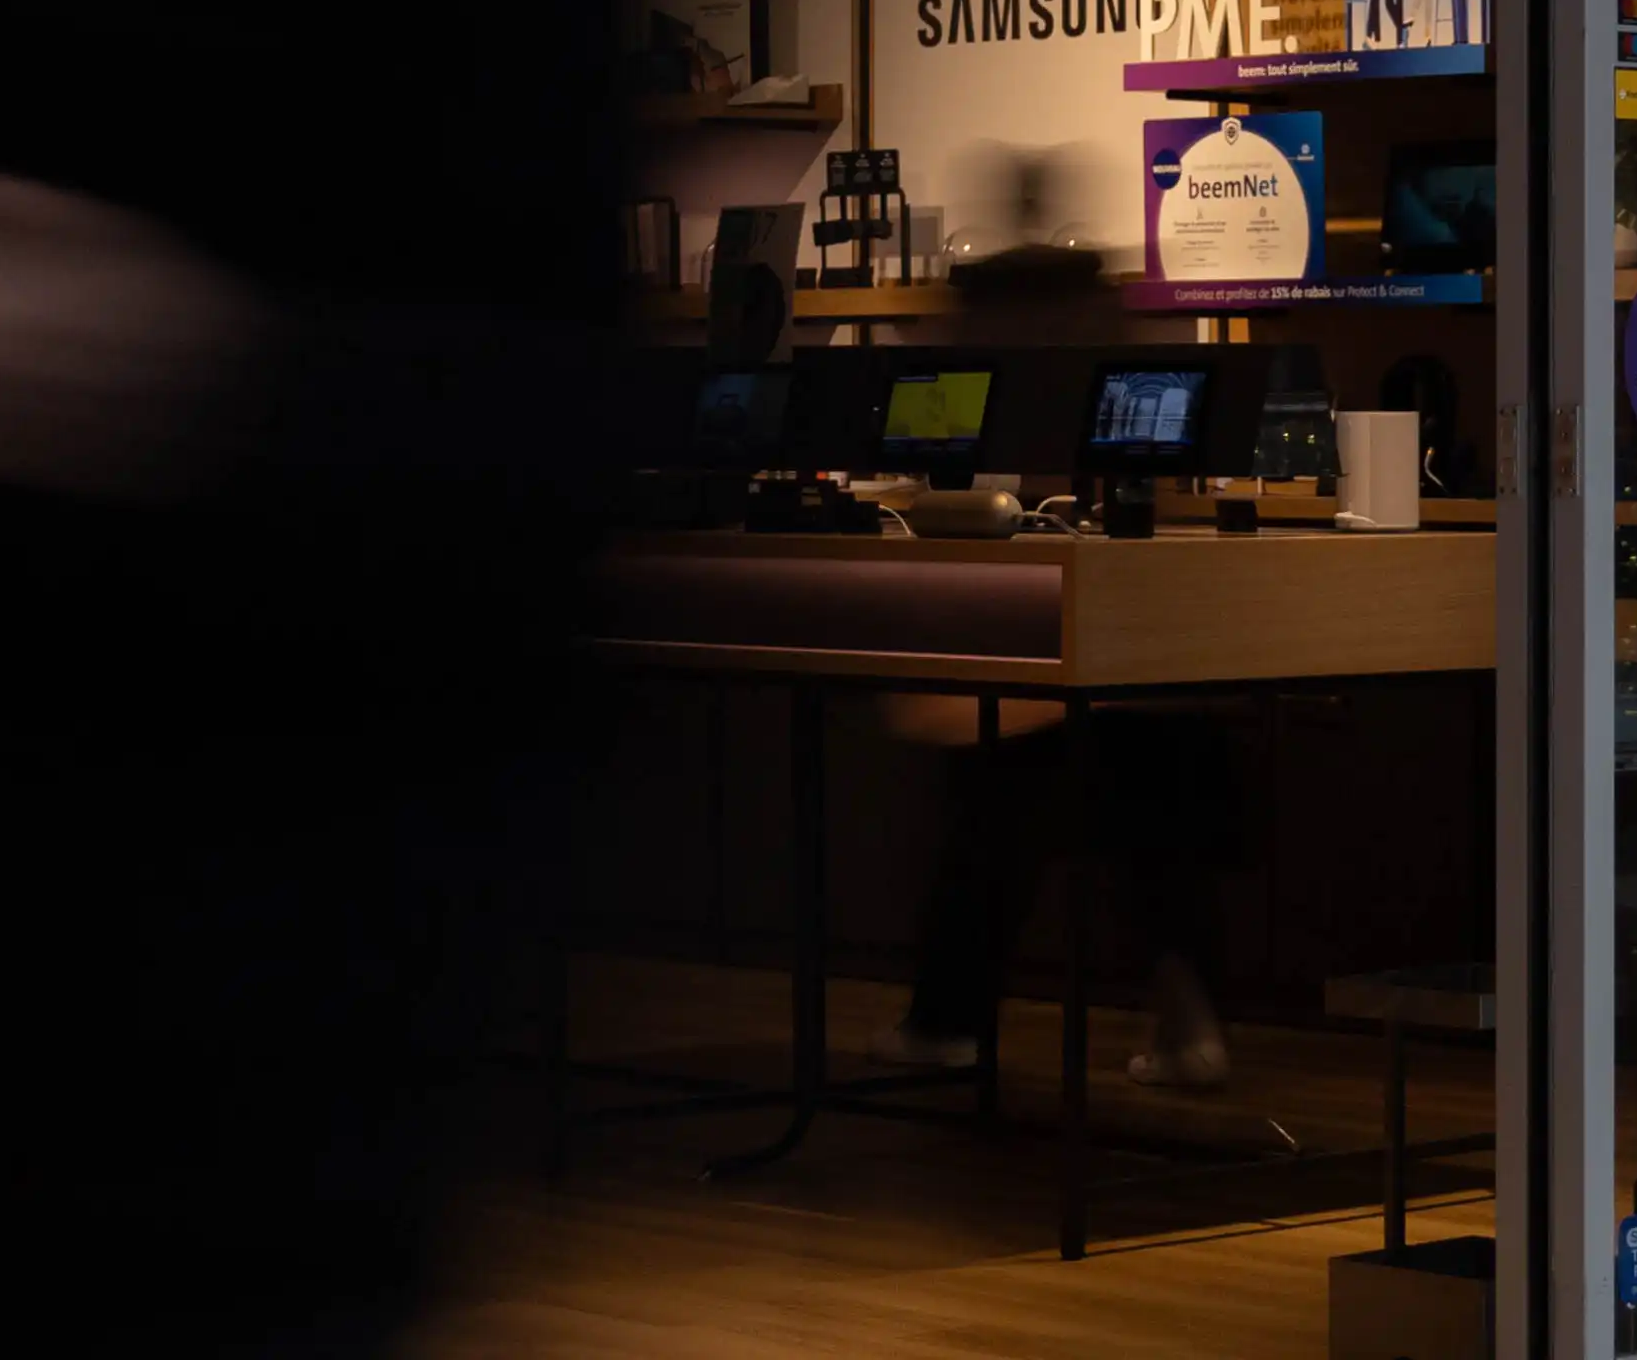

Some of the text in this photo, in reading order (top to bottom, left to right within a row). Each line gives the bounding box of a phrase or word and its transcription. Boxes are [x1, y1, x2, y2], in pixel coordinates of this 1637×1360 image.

[1267, 63, 1287, 77] tout
[1288, 60, 1341, 79] simplement
[1188, 172, 1279, 200] beemNet
[1290, 284, 1303, 300] de
